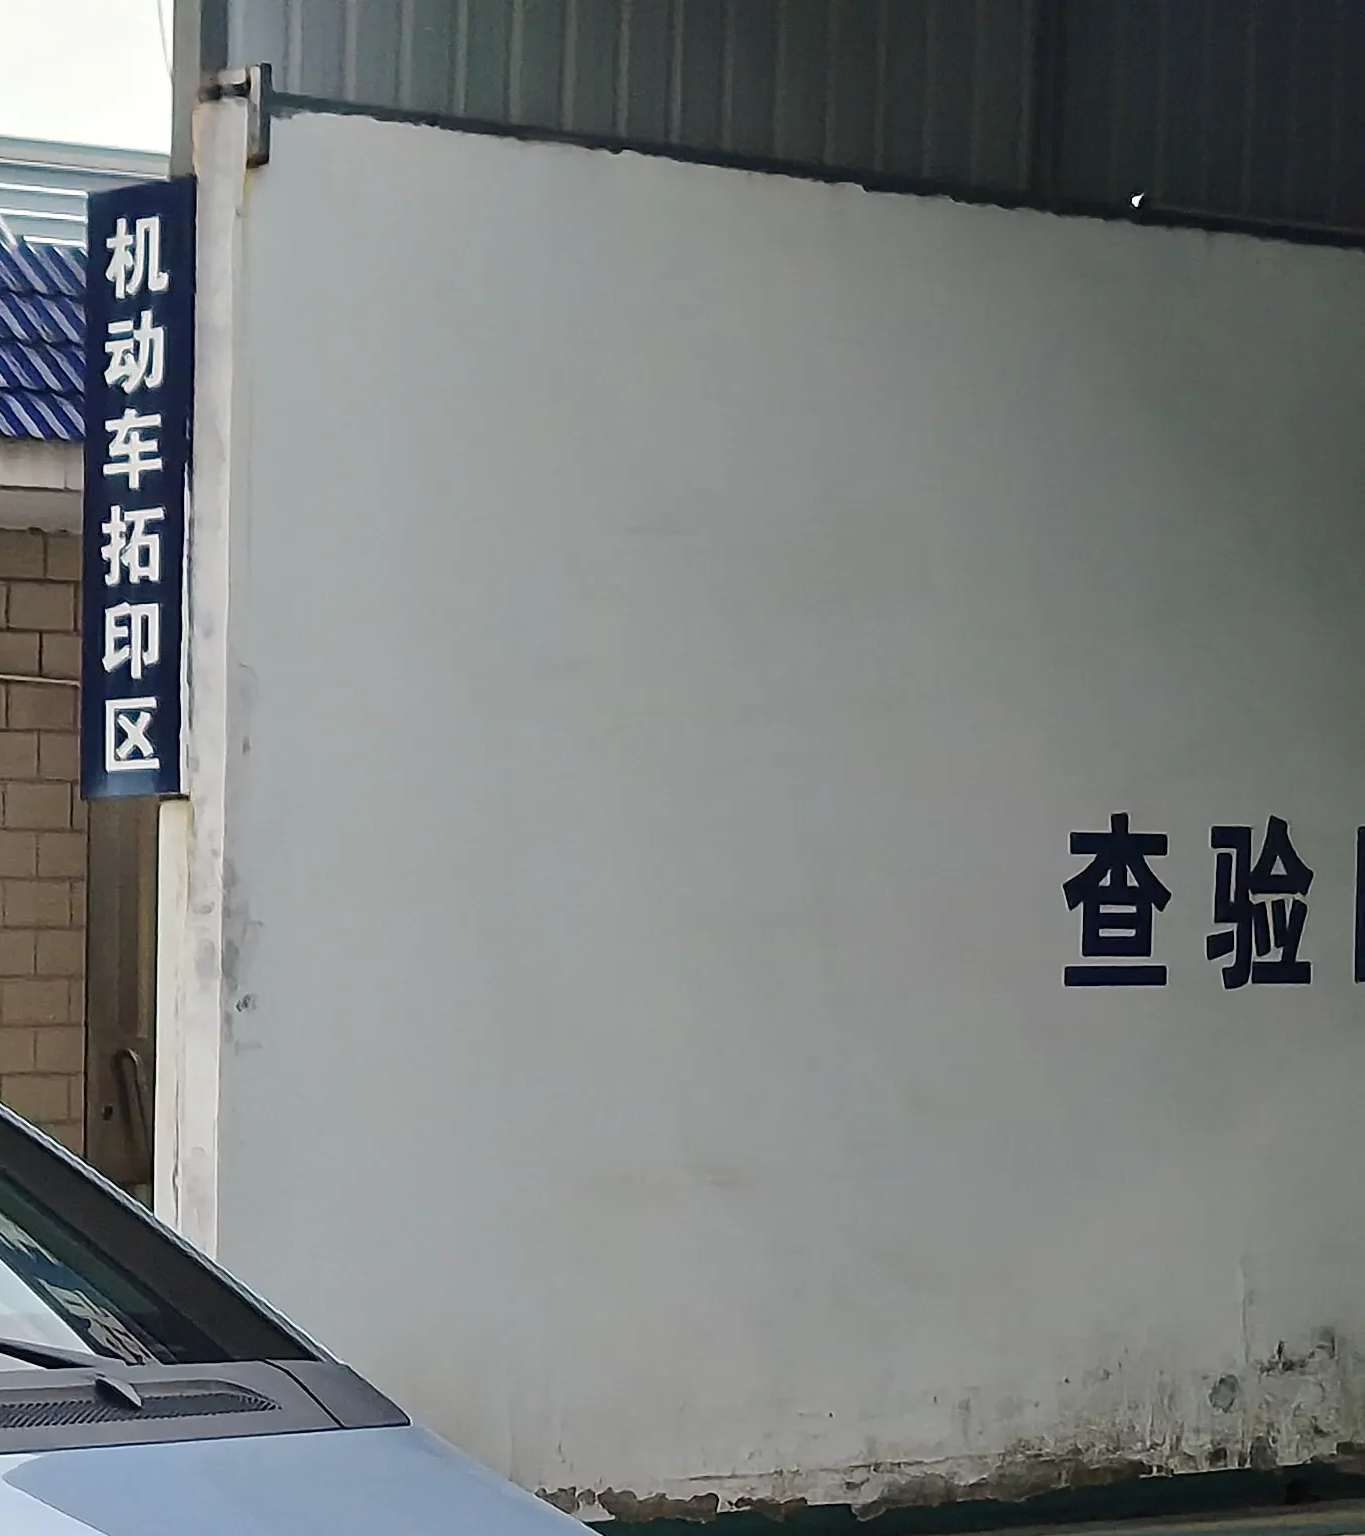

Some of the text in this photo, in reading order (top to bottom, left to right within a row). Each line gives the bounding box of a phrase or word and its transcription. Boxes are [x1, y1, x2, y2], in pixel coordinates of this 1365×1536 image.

[101, 215, 169, 773] 机动车拓印区
[1062, 812, 1365, 990] 查验
